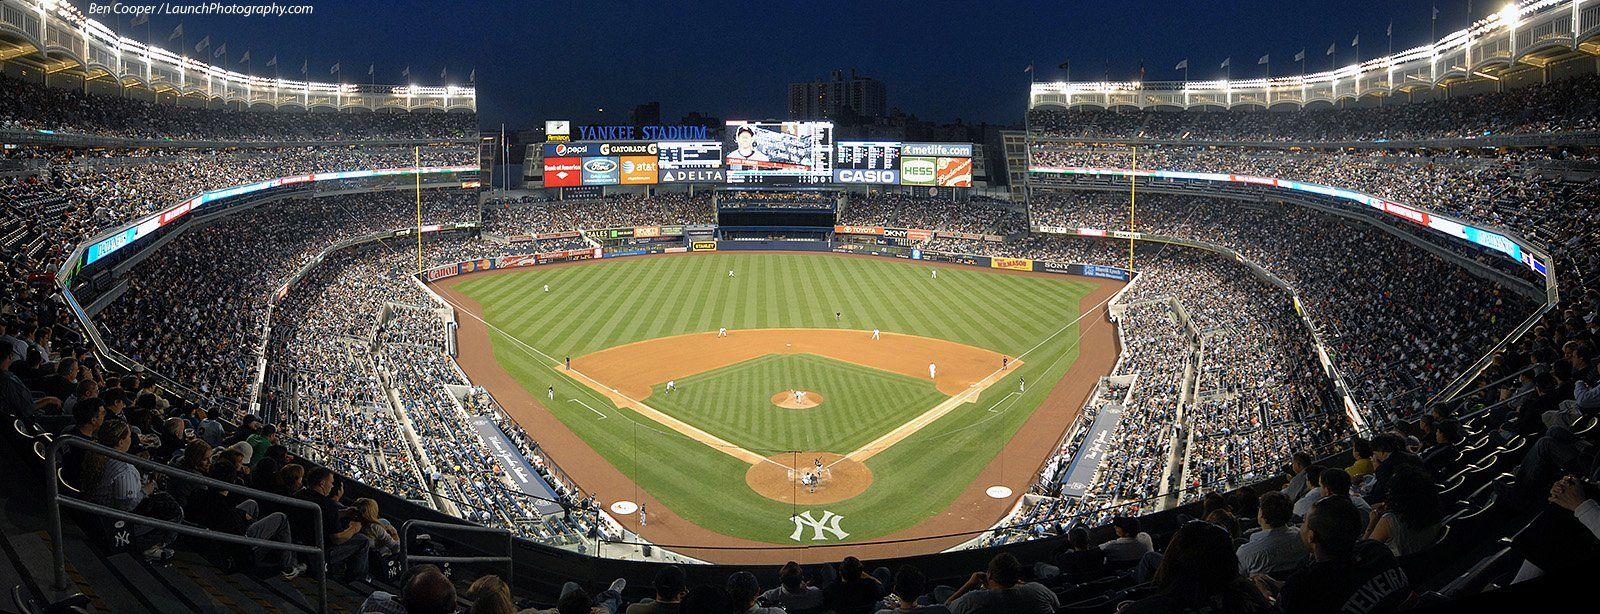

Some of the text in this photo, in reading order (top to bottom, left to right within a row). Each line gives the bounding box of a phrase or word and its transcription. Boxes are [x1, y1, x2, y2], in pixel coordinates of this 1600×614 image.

[578, 125, 708, 140] YANKEE STADIUM
[567, 145, 588, 154] pepsi
[611, 145, 647, 153] GATORADE
[911, 144, 970, 155] metlife.com
[591, 161, 610, 171] Ford
[635, 161, 656, 172] at&t
[904, 166, 933, 176] HESS
[677, 171, 723, 180] DELTA
[839, 170, 895, 183] CASIO
[1044, 262, 1070, 270] SONY
[428, 265, 458, 280] Canon
